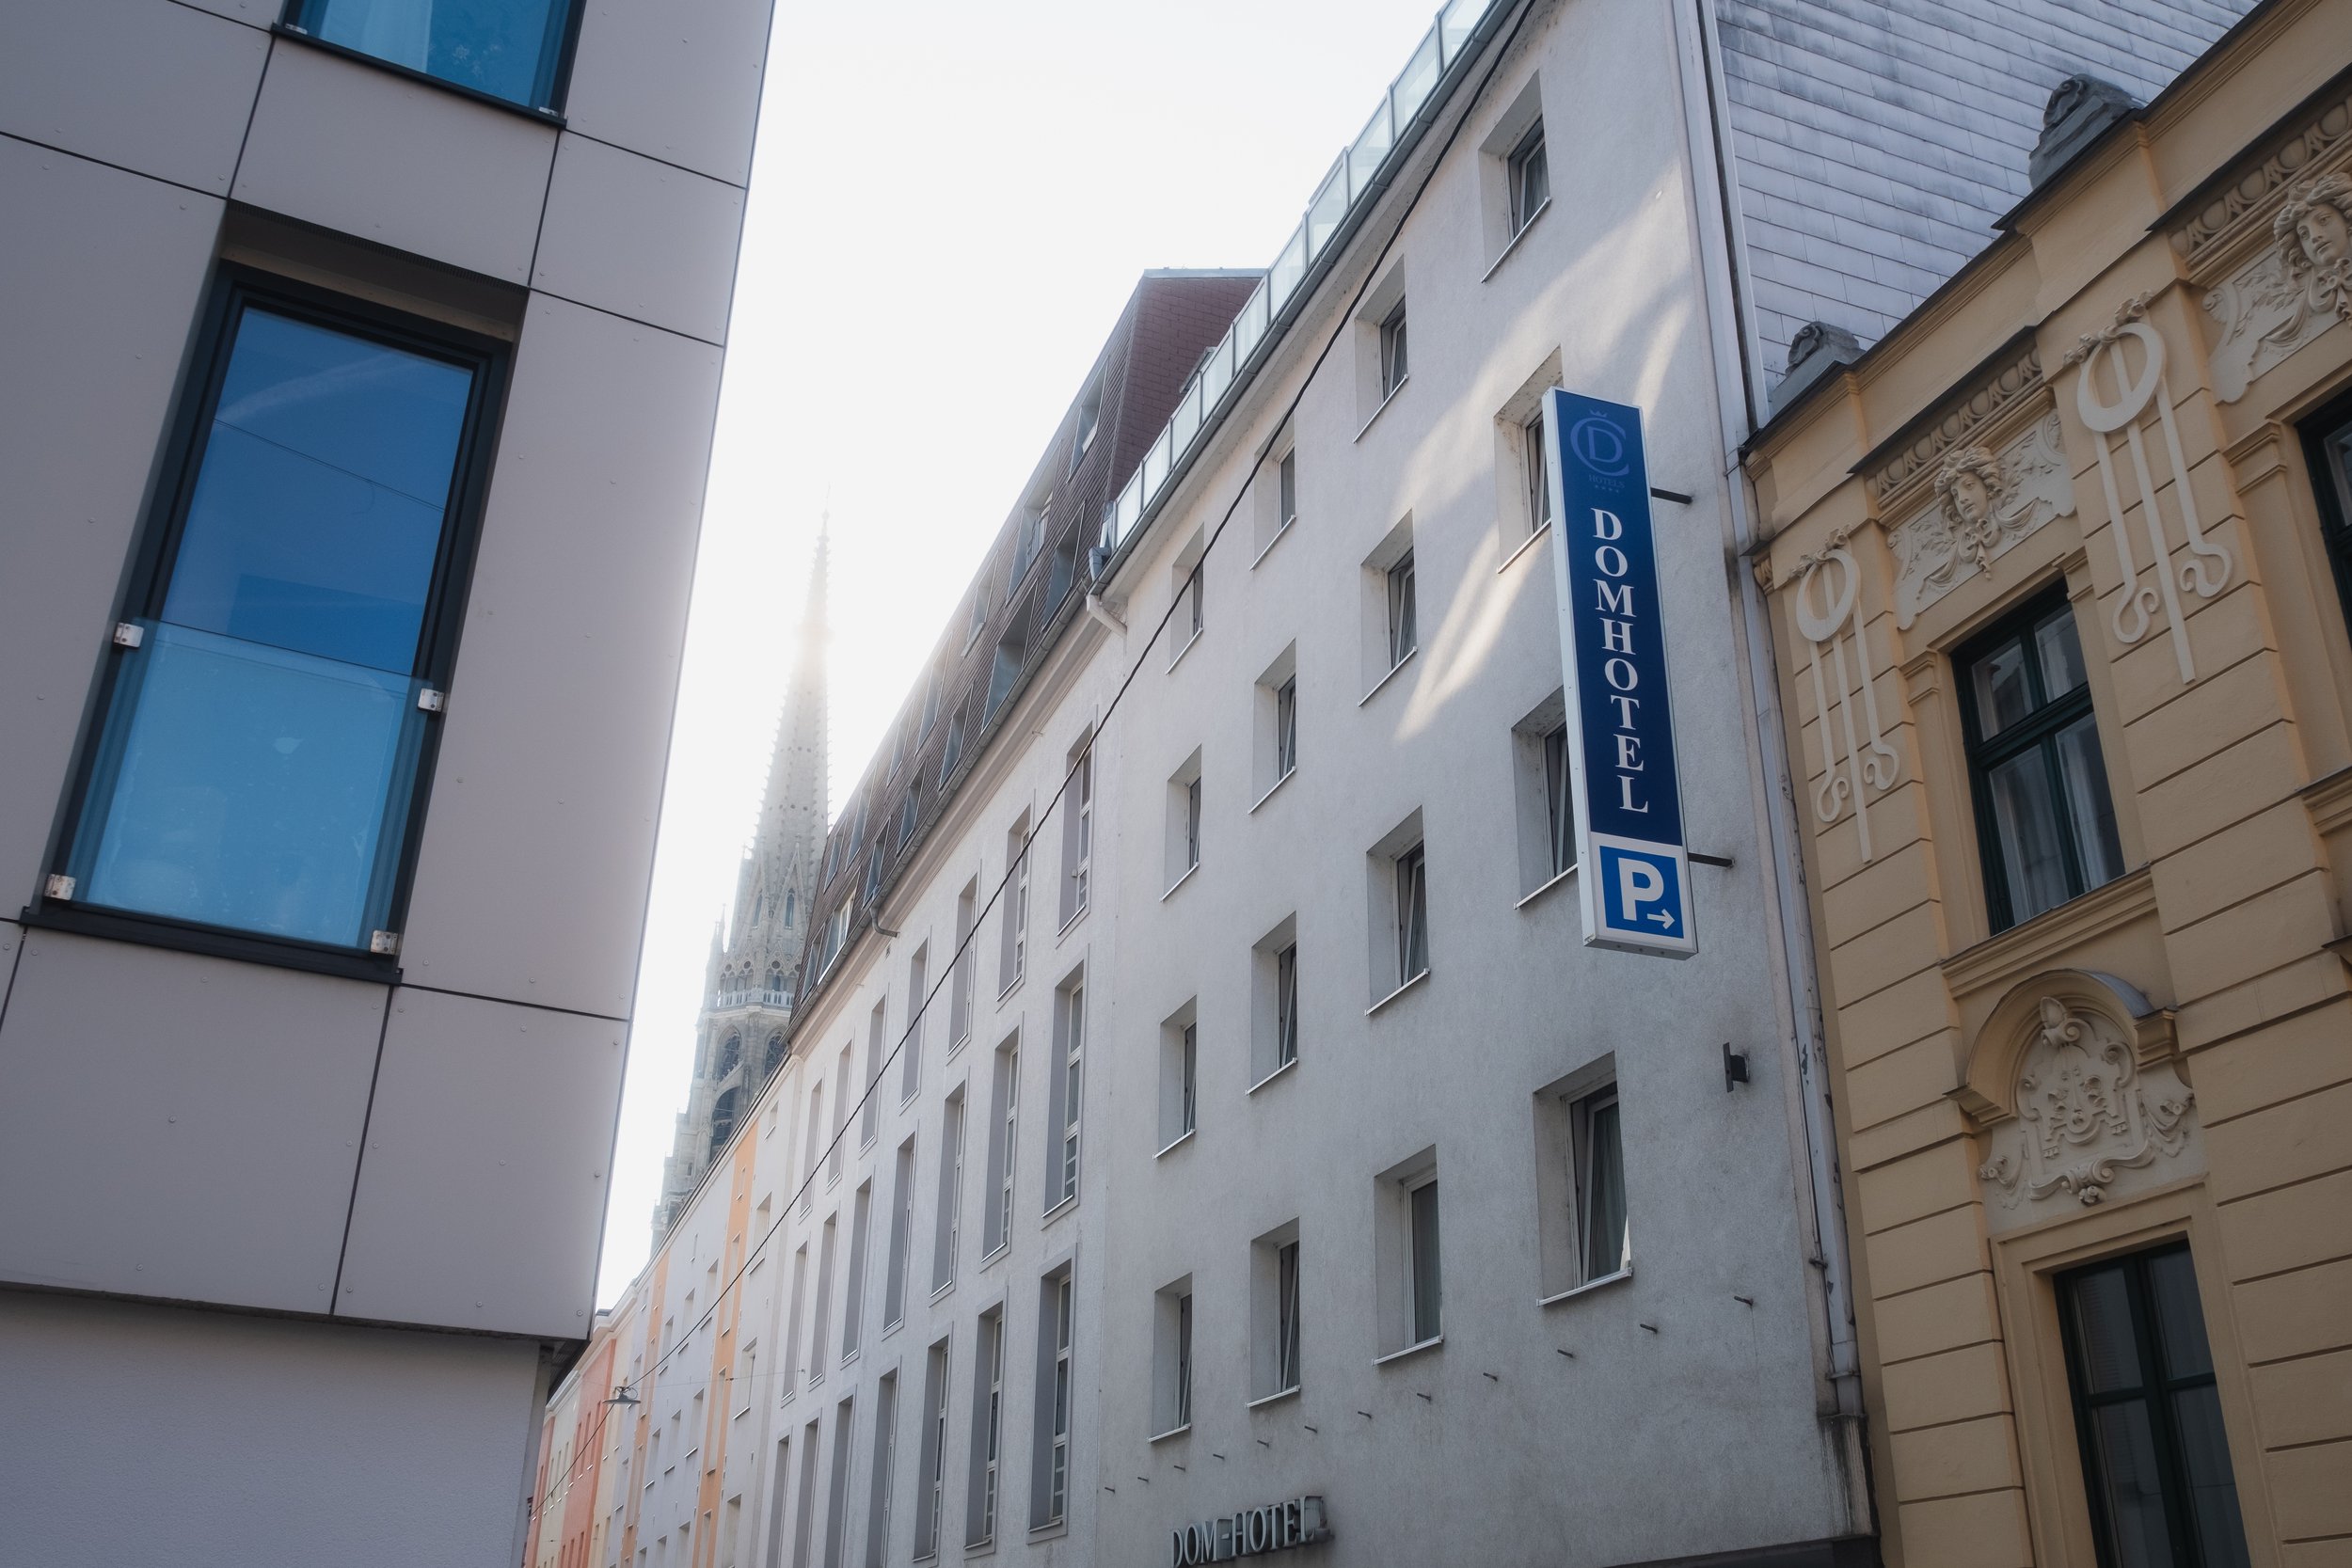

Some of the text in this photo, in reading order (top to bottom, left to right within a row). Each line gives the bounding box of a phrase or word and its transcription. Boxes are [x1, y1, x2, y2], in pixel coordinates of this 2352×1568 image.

[1589, 474, 1626, 488] HOTELS
[1592, 508, 1648, 814] DOMHOTEL
[1619, 859, 1664, 921] P
